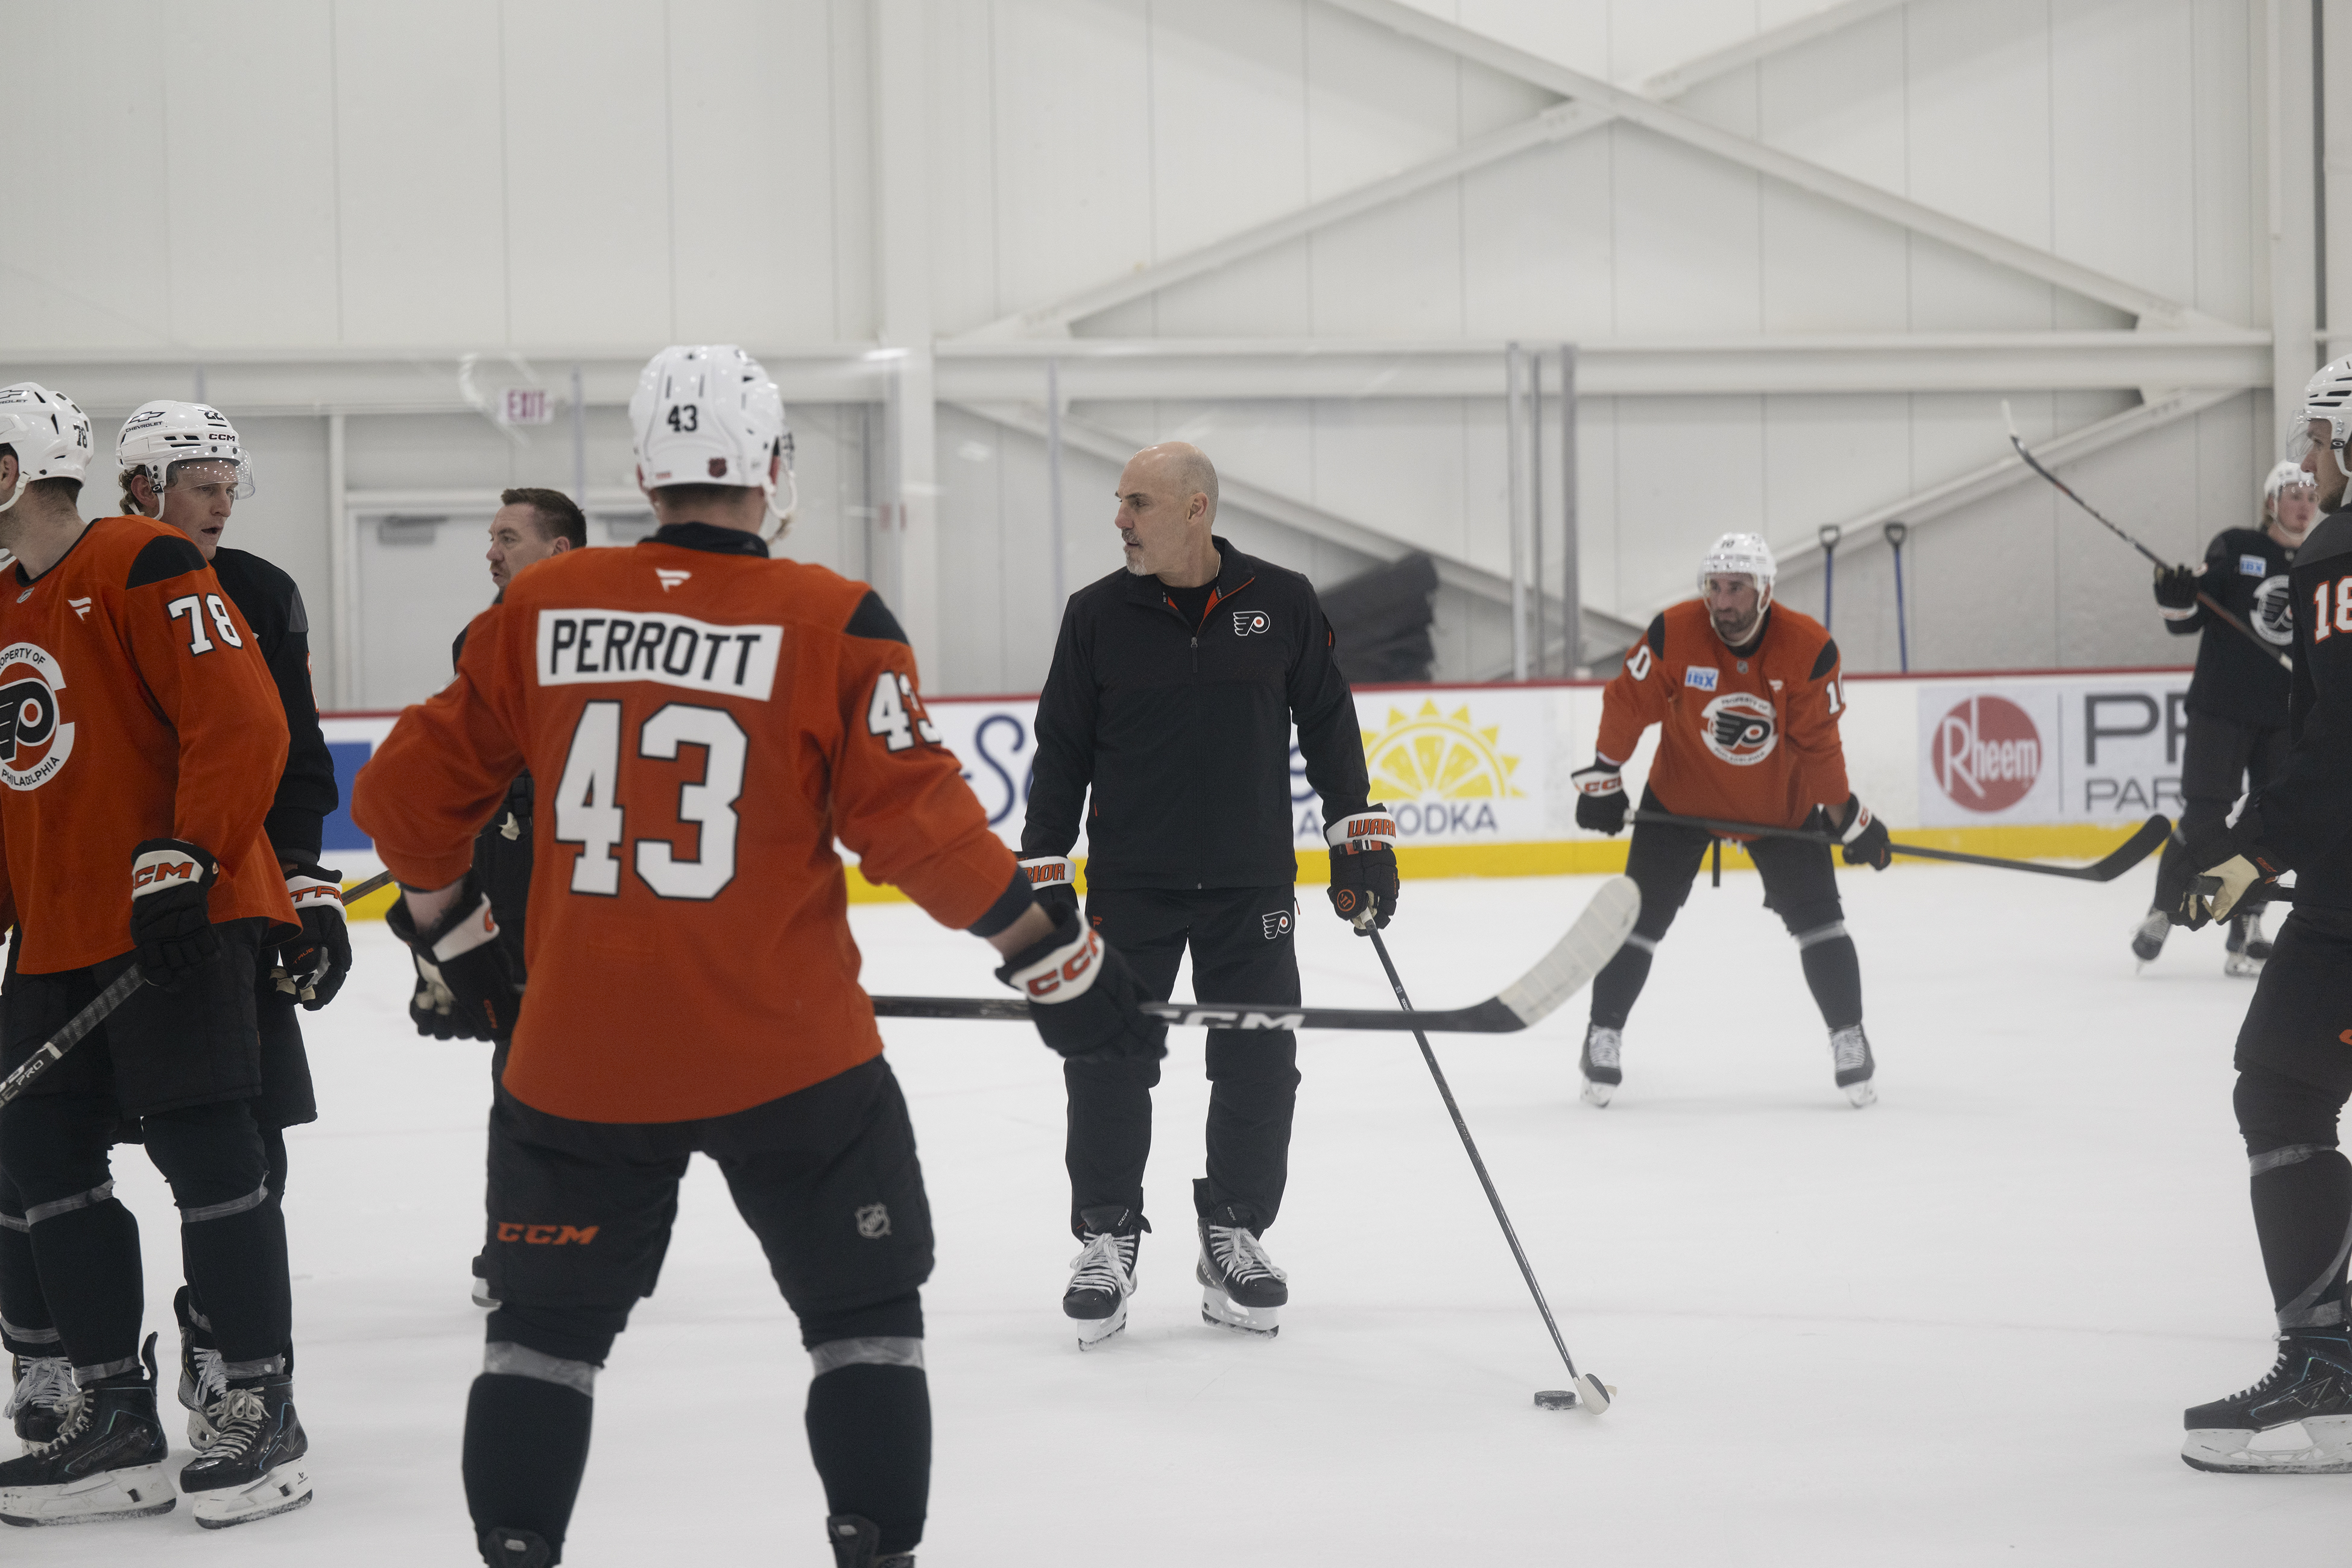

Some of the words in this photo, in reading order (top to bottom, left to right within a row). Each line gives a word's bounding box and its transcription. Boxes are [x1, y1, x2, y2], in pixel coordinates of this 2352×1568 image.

[508, 390, 546, 420] EXIT
[125, 421, 163, 432] CHEVROLET
[668, 405, 697, 432] 43
[73, 424, 88, 448] 78
[209, 433, 235, 441] CCM
[167, 593, 242, 657] 78
[0, 648, 32, 669] OPERTY
[33, 653, 46, 664] OF
[550, 618, 762, 686] PERROTT
[1688, 673, 1715, 688] IBX
[1943, 695, 2038, 798] Rheem
[554, 698, 749, 900] 43
[16, 1060, 44, 1086] PRO
[1118, 1209, 1130, 1227] CCM
[497, 1222, 599, 1246] CCM
